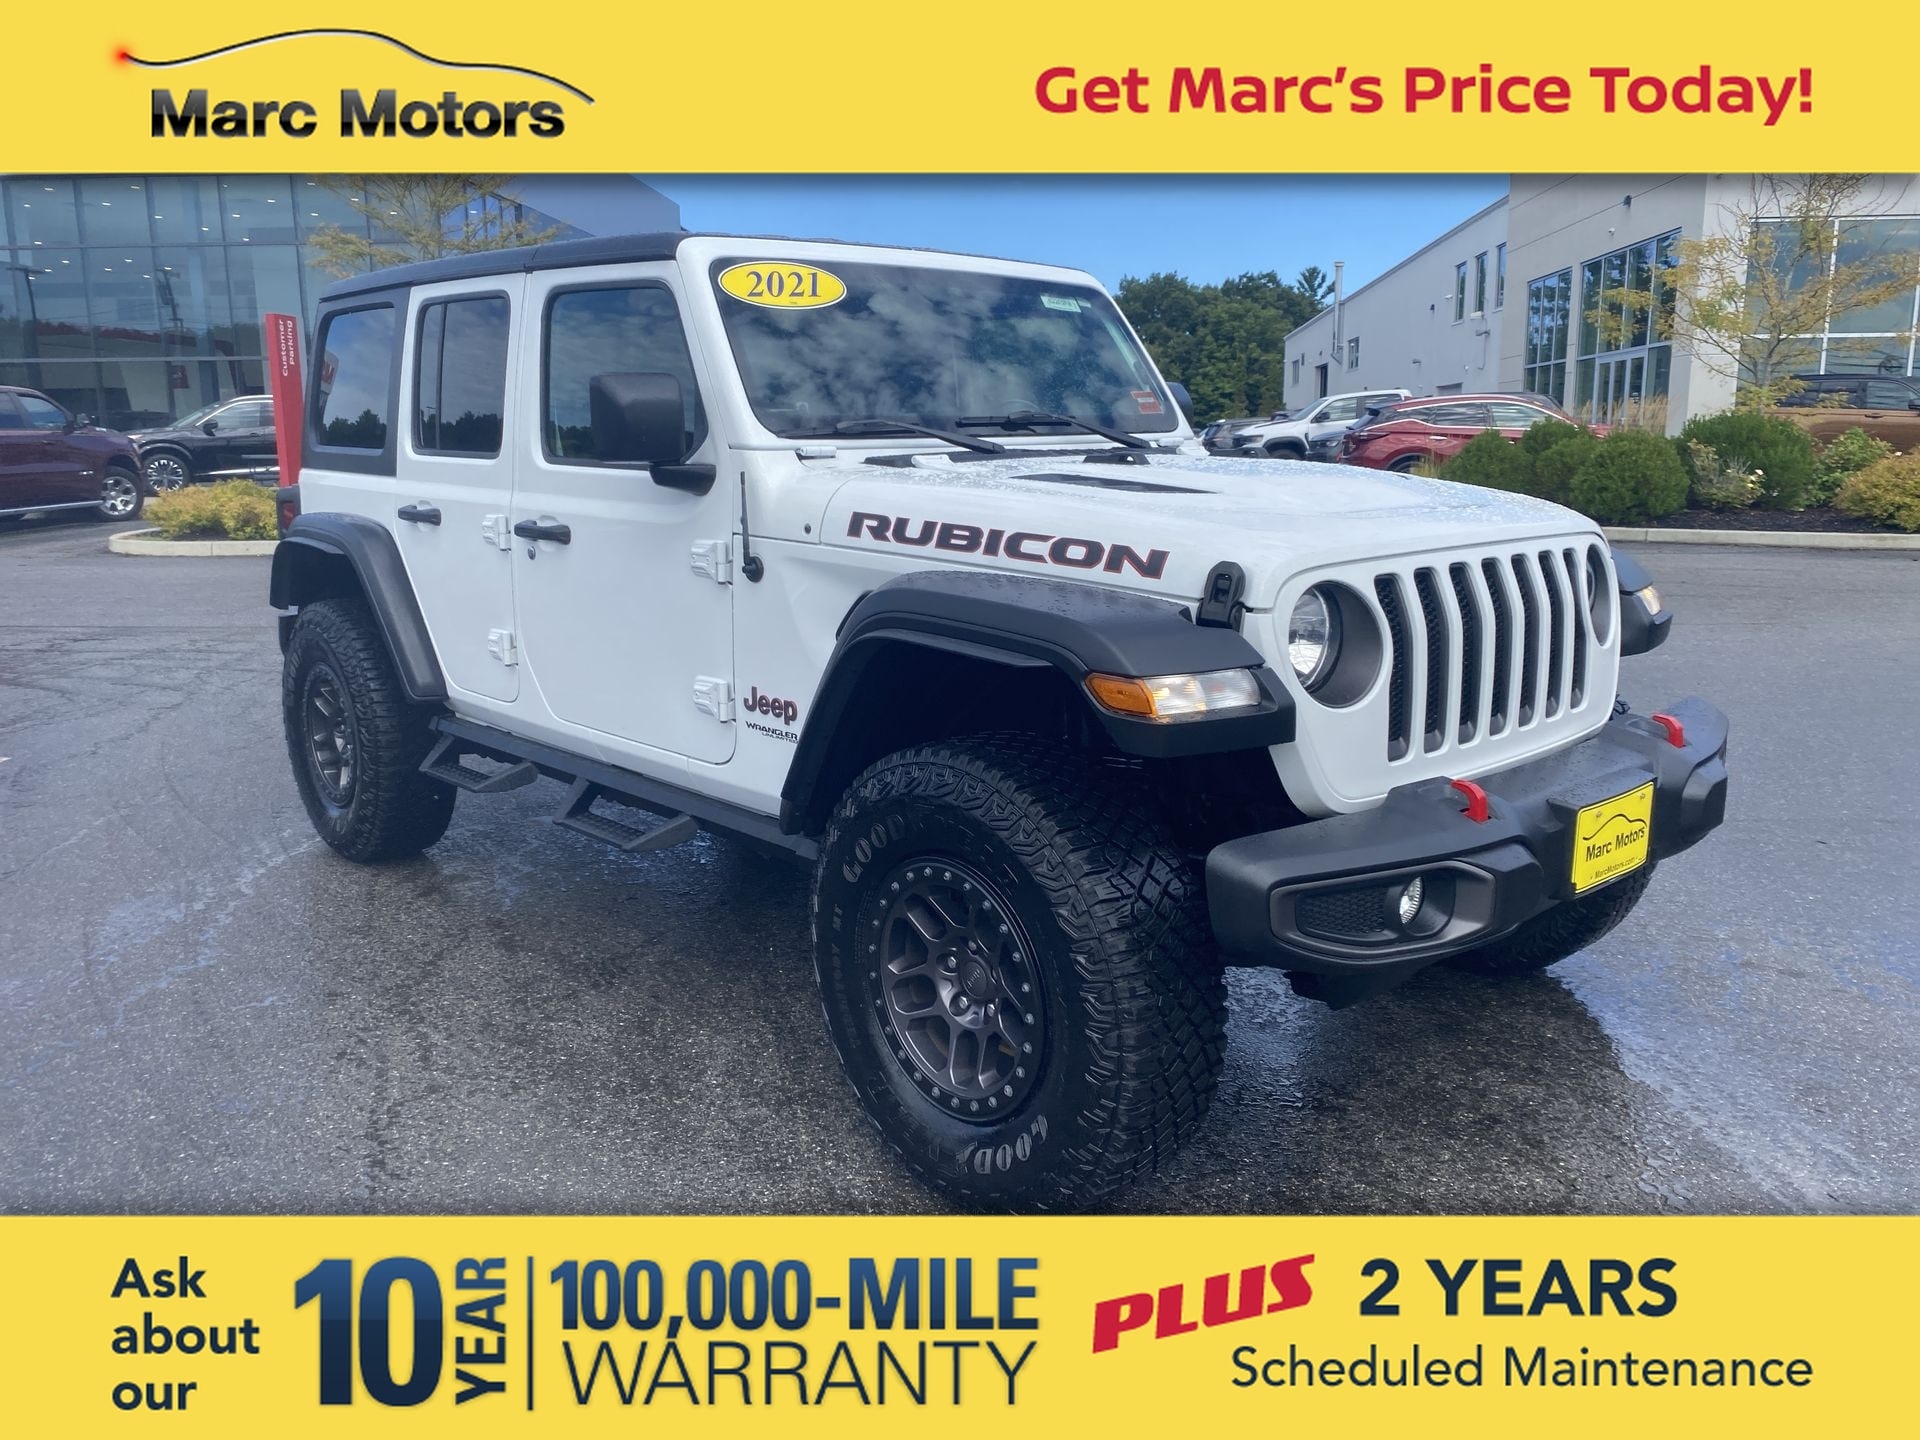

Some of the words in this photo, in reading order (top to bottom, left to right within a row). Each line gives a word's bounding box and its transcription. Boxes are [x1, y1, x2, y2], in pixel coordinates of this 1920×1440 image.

[745, 270, 822, 297] 2021
[279, 319, 288, 377] Customer
[847, 511, 1170, 580] RUBICON
[743, 686, 798, 726] Jeep
[745, 720, 798, 741] WRANGLER
[1585, 842, 1612, 862] Marc
[1615, 826, 1645, 851] Motors
